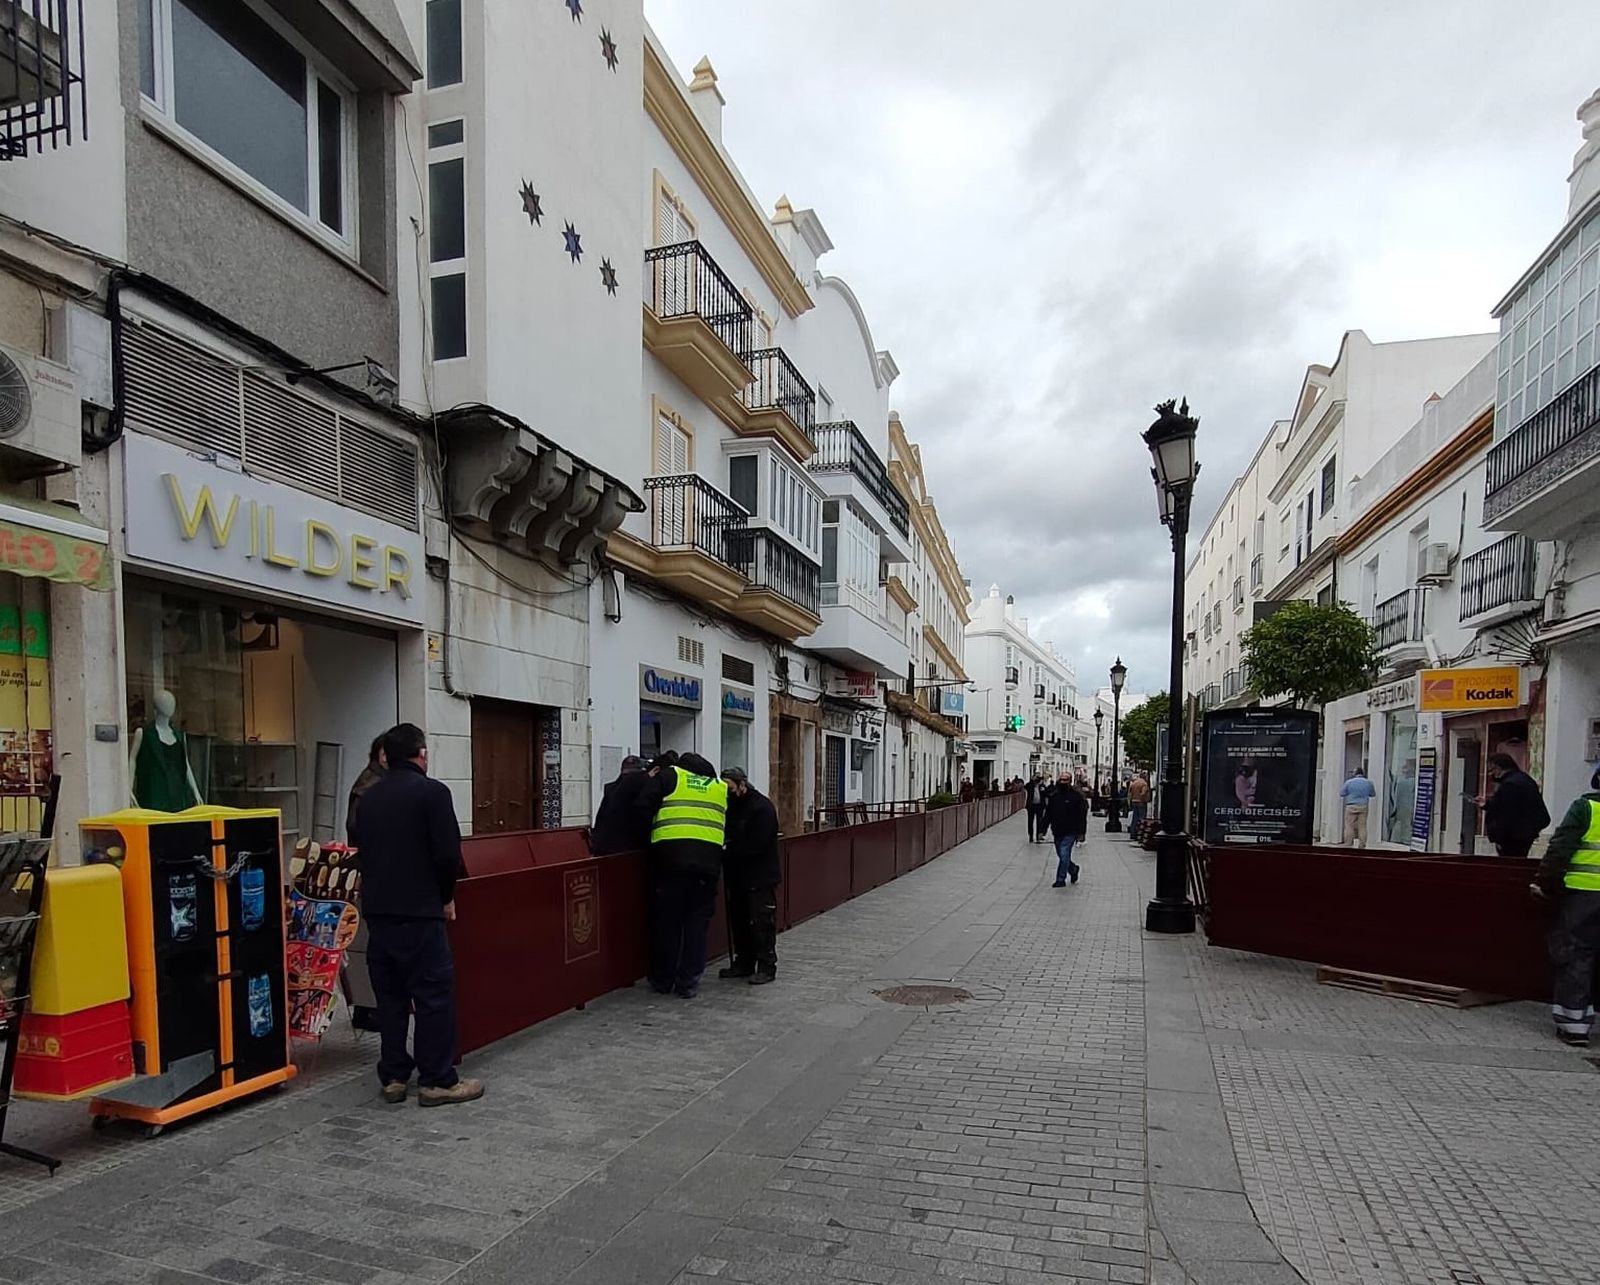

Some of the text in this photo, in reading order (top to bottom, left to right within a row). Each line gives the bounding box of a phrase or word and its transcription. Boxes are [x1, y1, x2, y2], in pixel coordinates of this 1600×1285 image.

[160, 472, 412, 600] WILDER
[73, 544, 101, 580] 2
[1456, 675, 1513, 687] PRODUCTOS
[1466, 687, 1514, 701] Kodak
[1214, 806, 1301, 817] CERO DIECISÉIS
